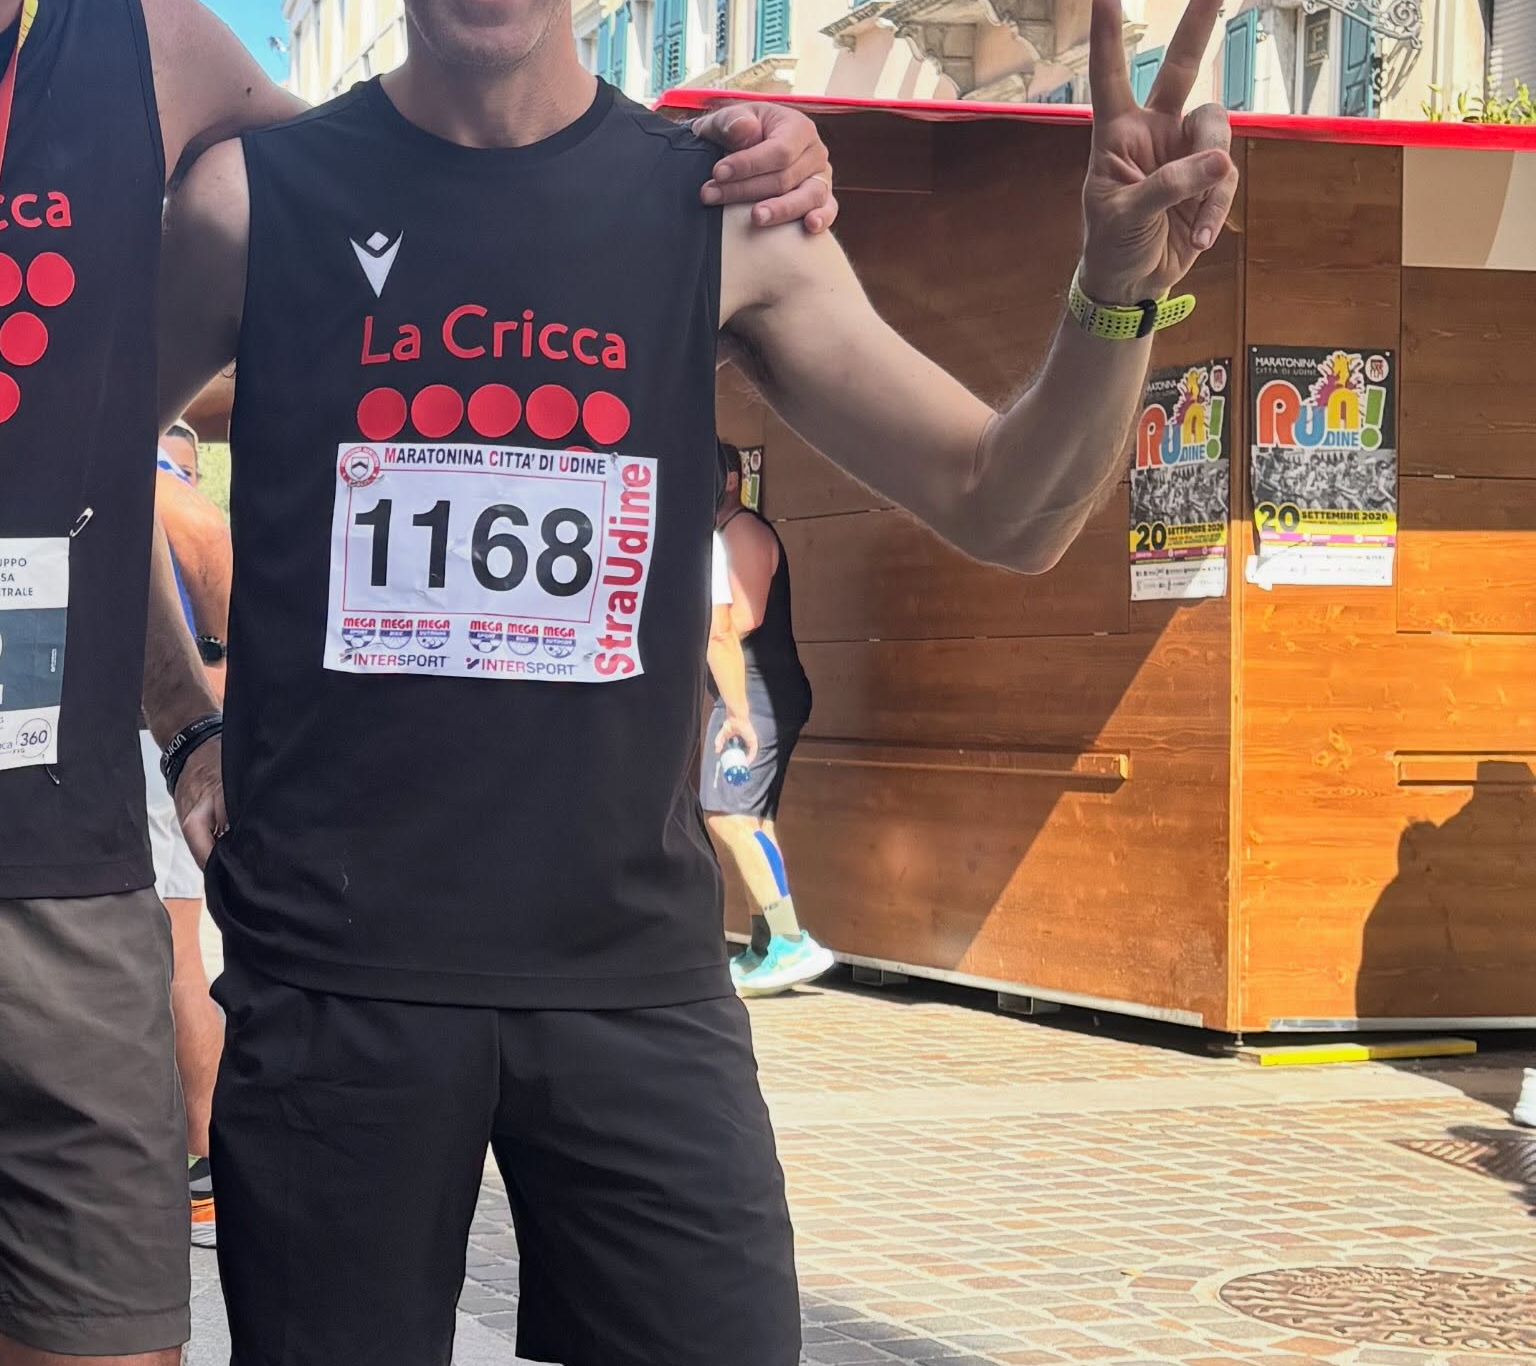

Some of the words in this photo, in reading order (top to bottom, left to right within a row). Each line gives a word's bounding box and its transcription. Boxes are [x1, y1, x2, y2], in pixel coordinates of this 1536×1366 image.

[361, 315, 421, 365] La
[442, 304, 627, 370] Cricca
[1255, 357, 1317, 368] MARATONINA
[384, 447, 484, 466] MARATONINA
[540, 452, 554, 470] DI
[559, 455, 606, 475] UDINE
[1259, 503, 1301, 532] 20
[1136, 522, 1166, 552] 20
[354, 498, 594, 597] 1168
[593, 461, 652, 676] StraUdine
[343, 617, 376, 628] MEGA
[380, 618, 413, 629] MEGA
[417, 619, 450, 629] MEGA
[470, 619, 503, 632] MEGA
[507, 622, 539, 635] MEGA
[543, 625, 575, 638] MEGA
[353, 653, 449, 668] INTERSPORT
[481, 658, 576, 676] INTERSPORT
[20, 730, 48, 747] 360
